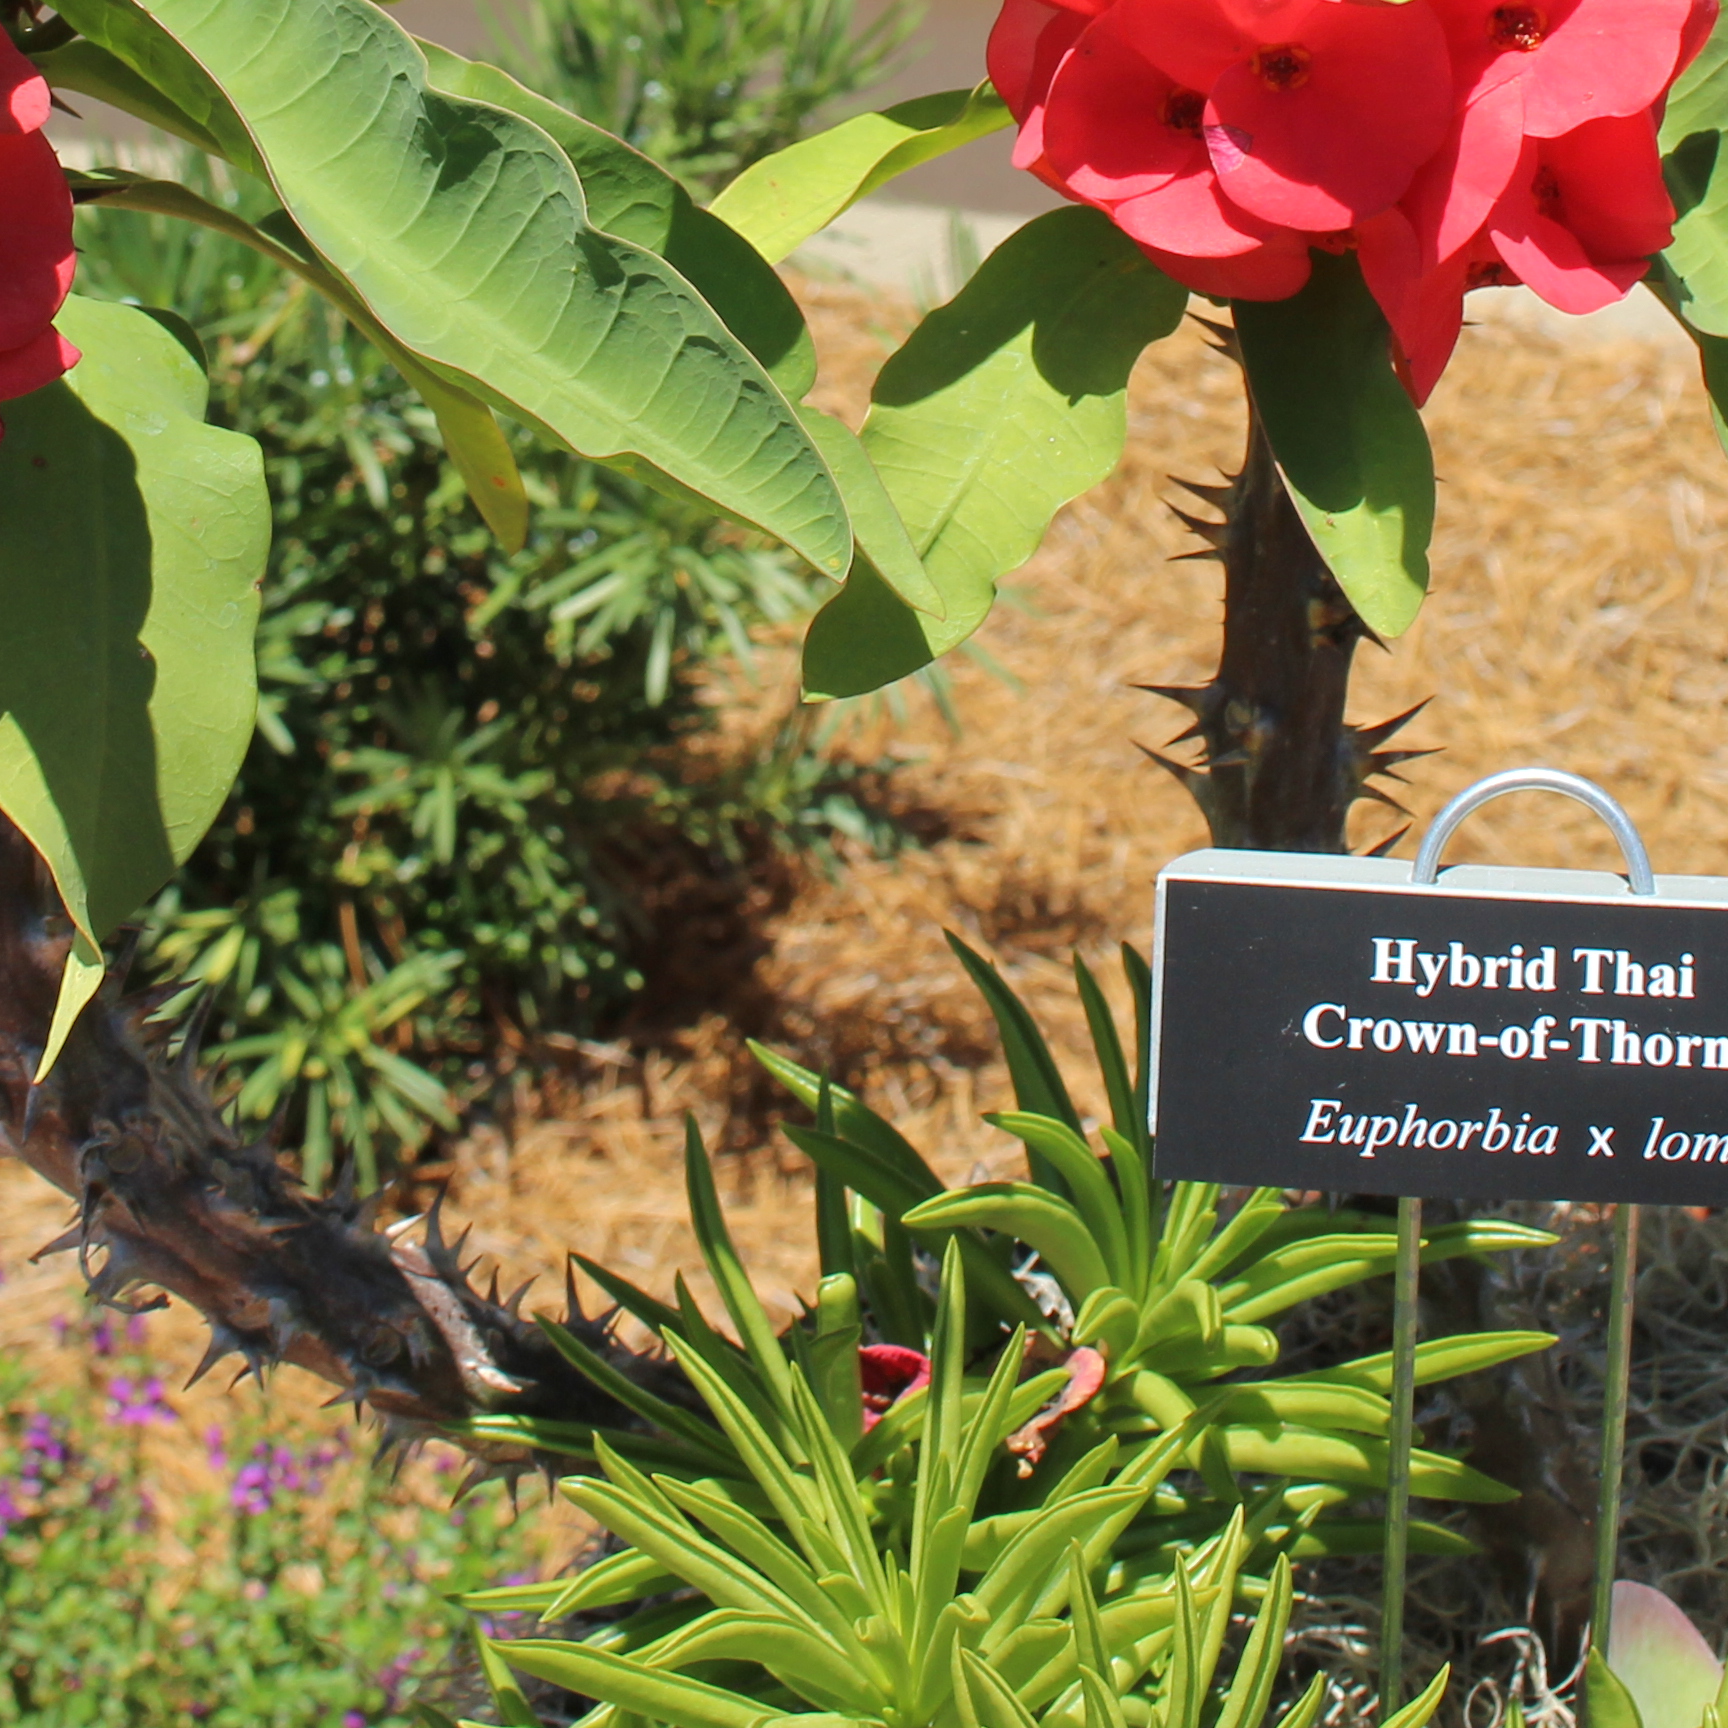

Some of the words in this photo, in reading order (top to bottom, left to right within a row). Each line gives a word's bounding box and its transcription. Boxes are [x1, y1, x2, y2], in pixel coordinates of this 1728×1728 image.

[1369, 937, 1557, 998] Hybrid
[1572, 948, 1695, 999] Thai
[1298, 1099, 1559, 1158] Euphorbia
[1587, 1125, 1615, 1157] x
